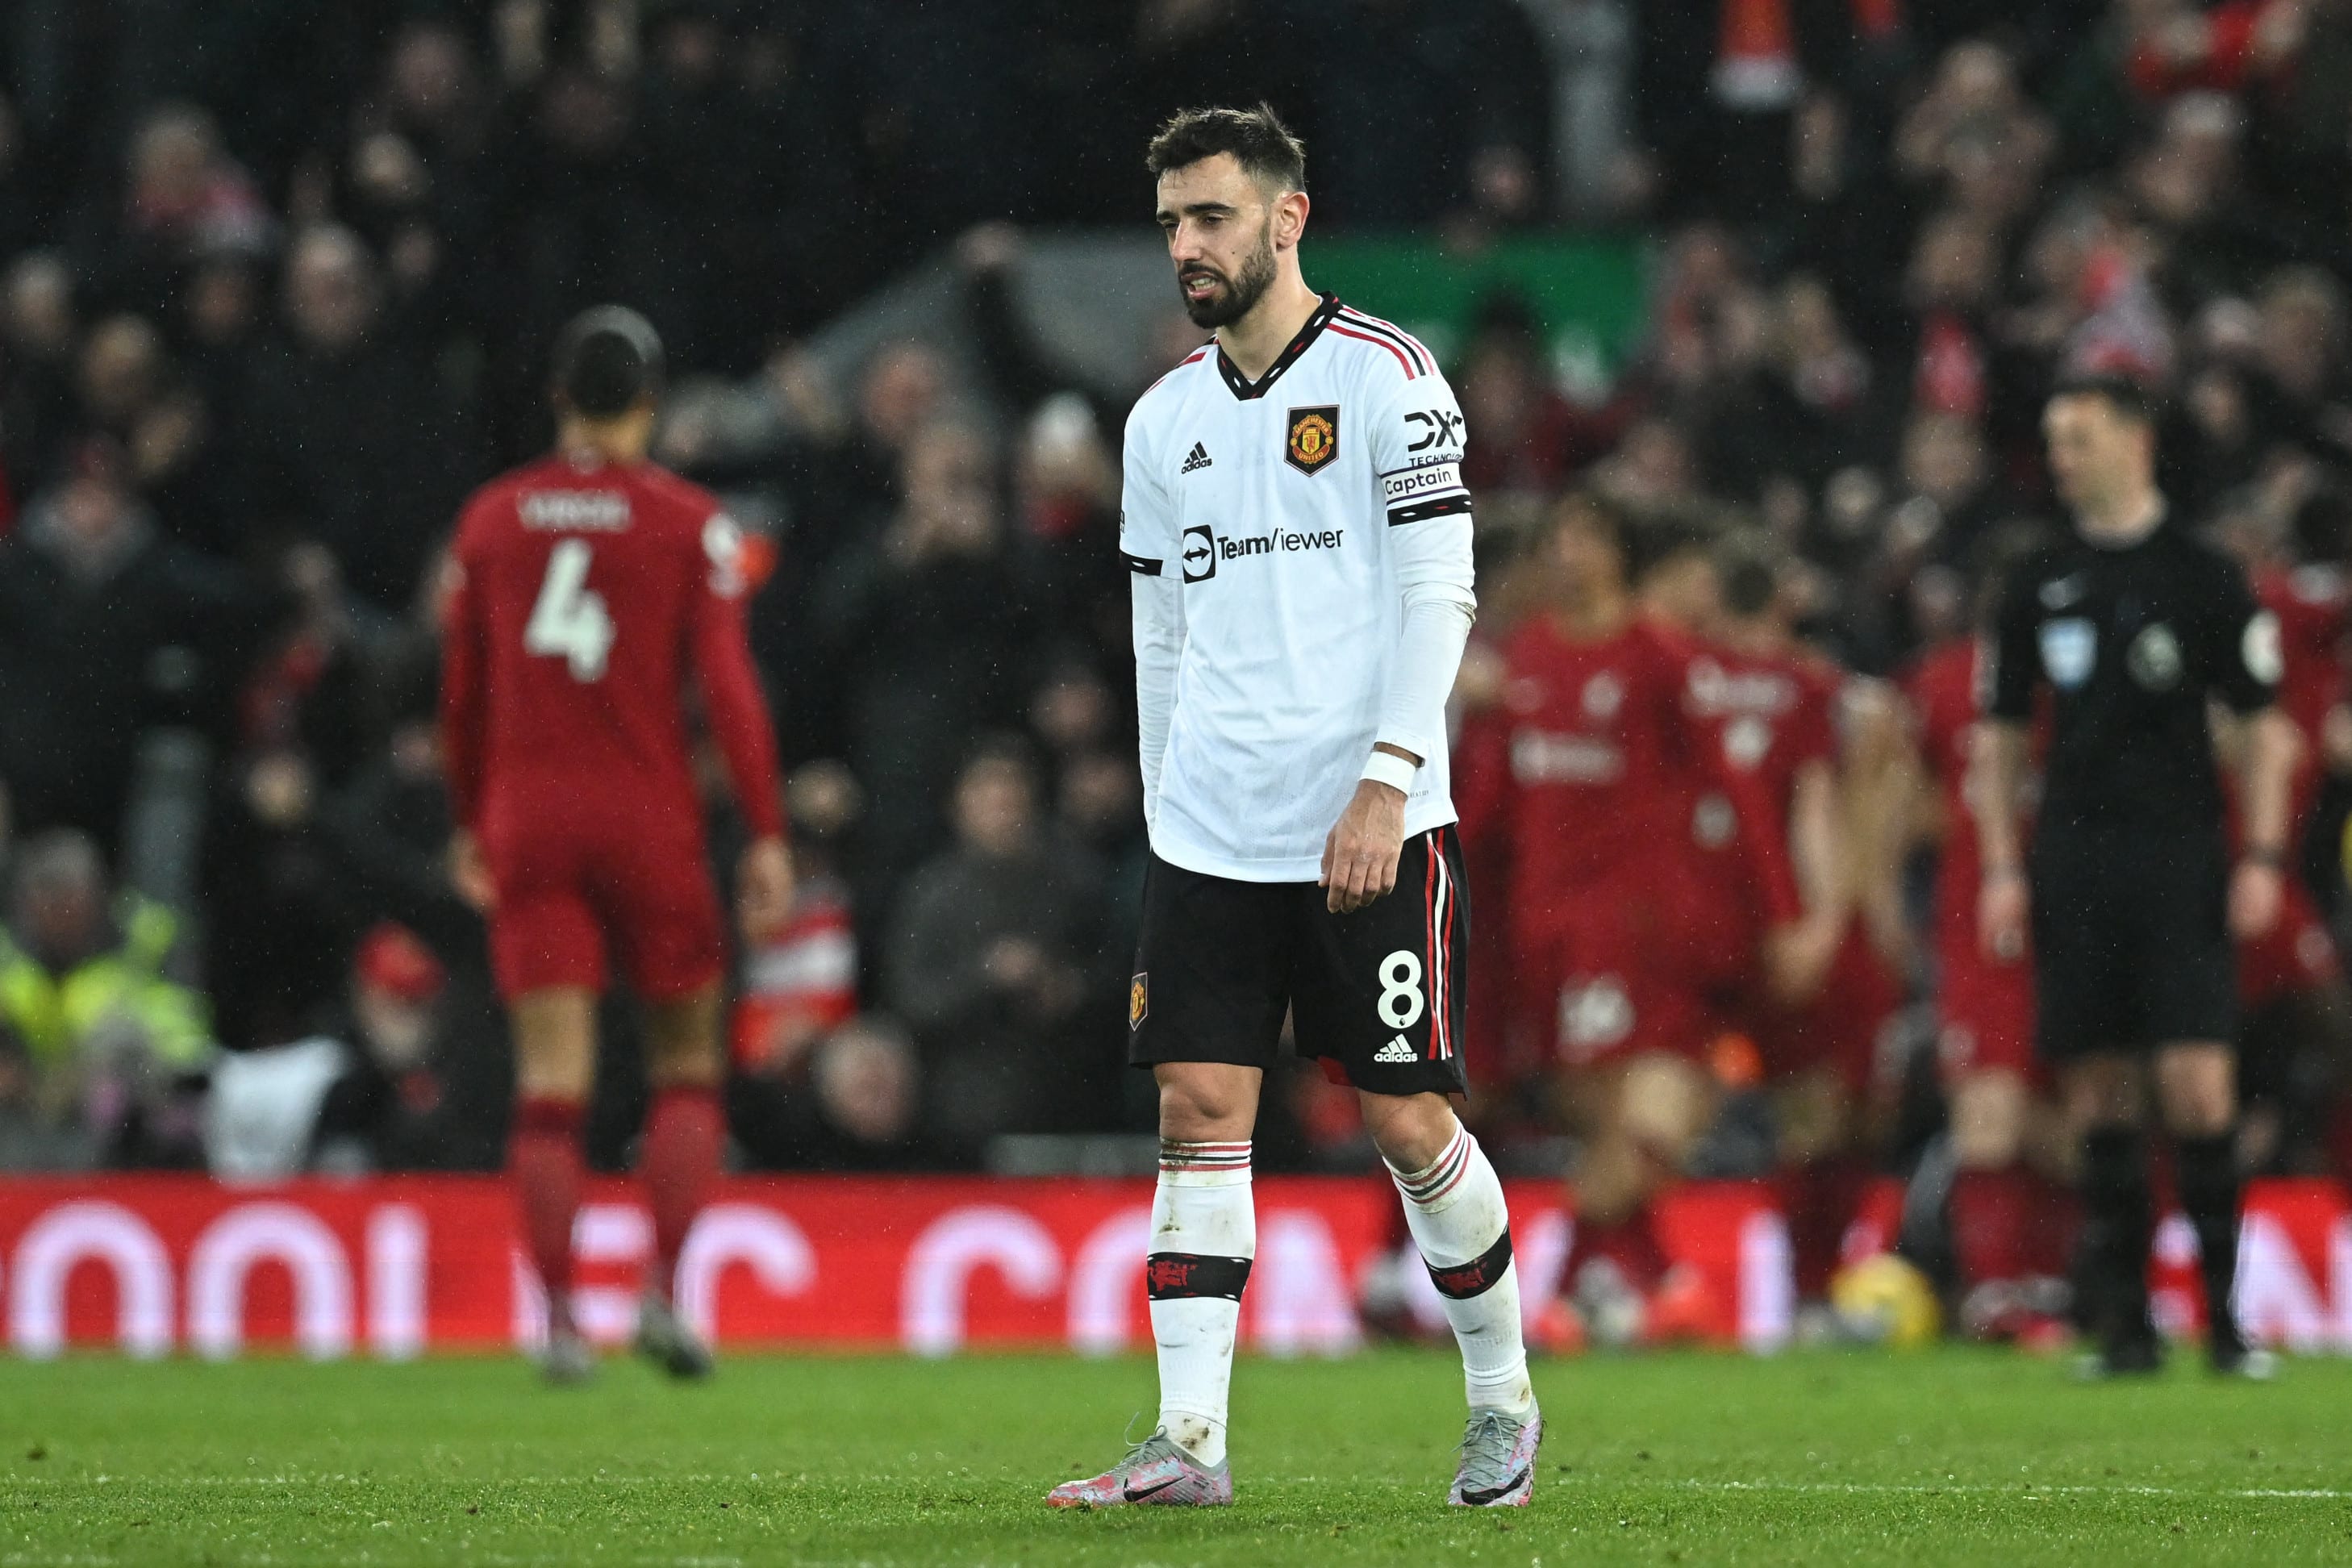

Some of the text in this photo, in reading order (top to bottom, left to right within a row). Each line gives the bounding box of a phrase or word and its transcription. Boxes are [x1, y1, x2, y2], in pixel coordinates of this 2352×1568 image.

[1295, 417, 1329, 434] MANCHESTER
[1181, 458, 1212, 474] adidas
[1299, 452, 1324, 461] UNITED
[1385, 468, 1452, 494] Captain
[1217, 528, 1344, 561] TeamViewer
[525, 538, 615, 682] 4
[1378, 950, 1424, 1028] 8
[1374, 1053, 1418, 1062] adidas
